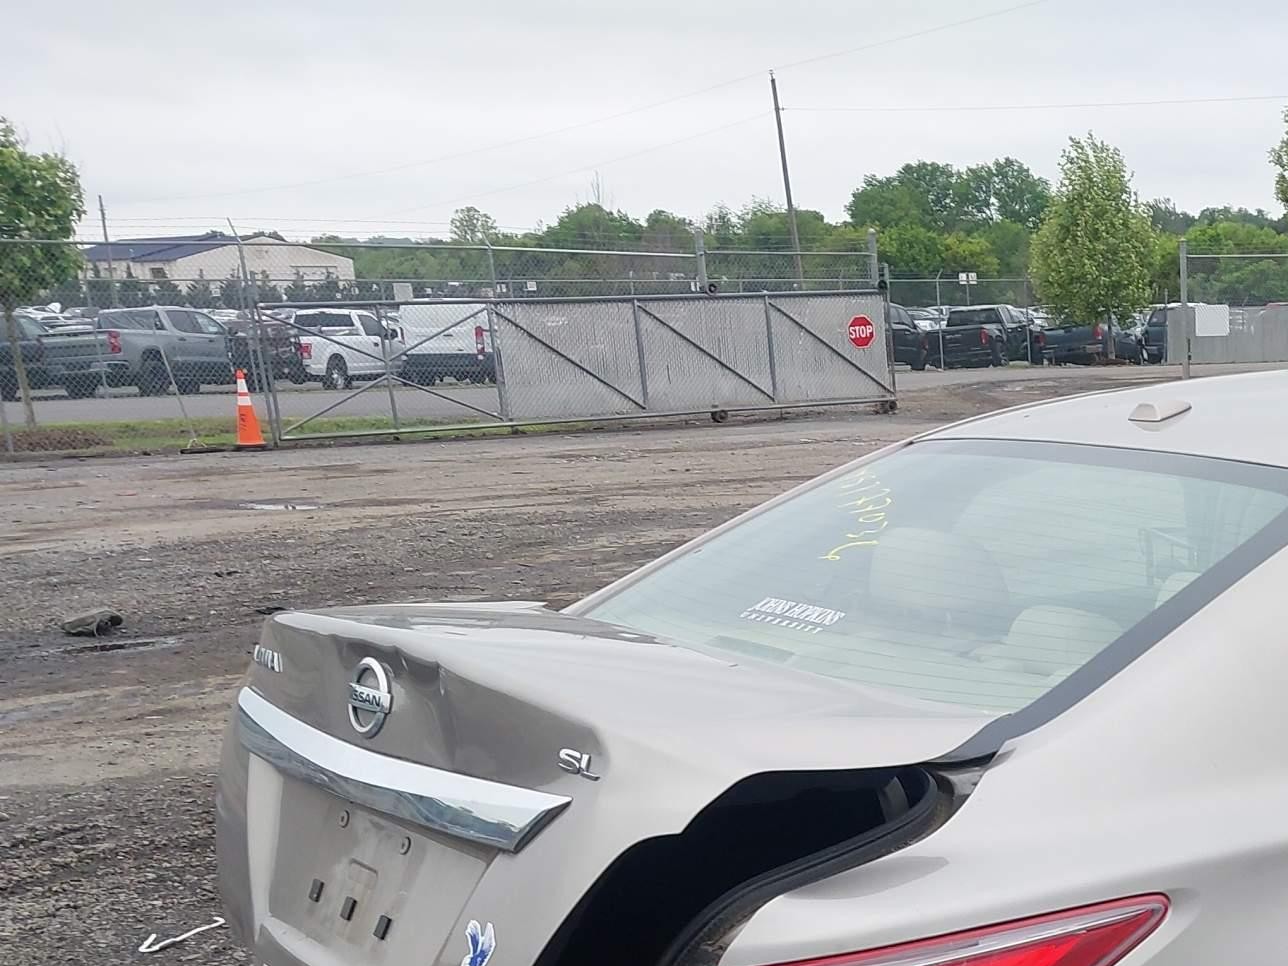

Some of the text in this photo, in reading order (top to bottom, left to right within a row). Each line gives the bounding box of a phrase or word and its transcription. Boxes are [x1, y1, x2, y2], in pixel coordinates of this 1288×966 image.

[849, 325, 873, 339] STOP
[746, 596, 847, 626] JOHNS HOPKINS
[557, 748, 601, 782] SL
